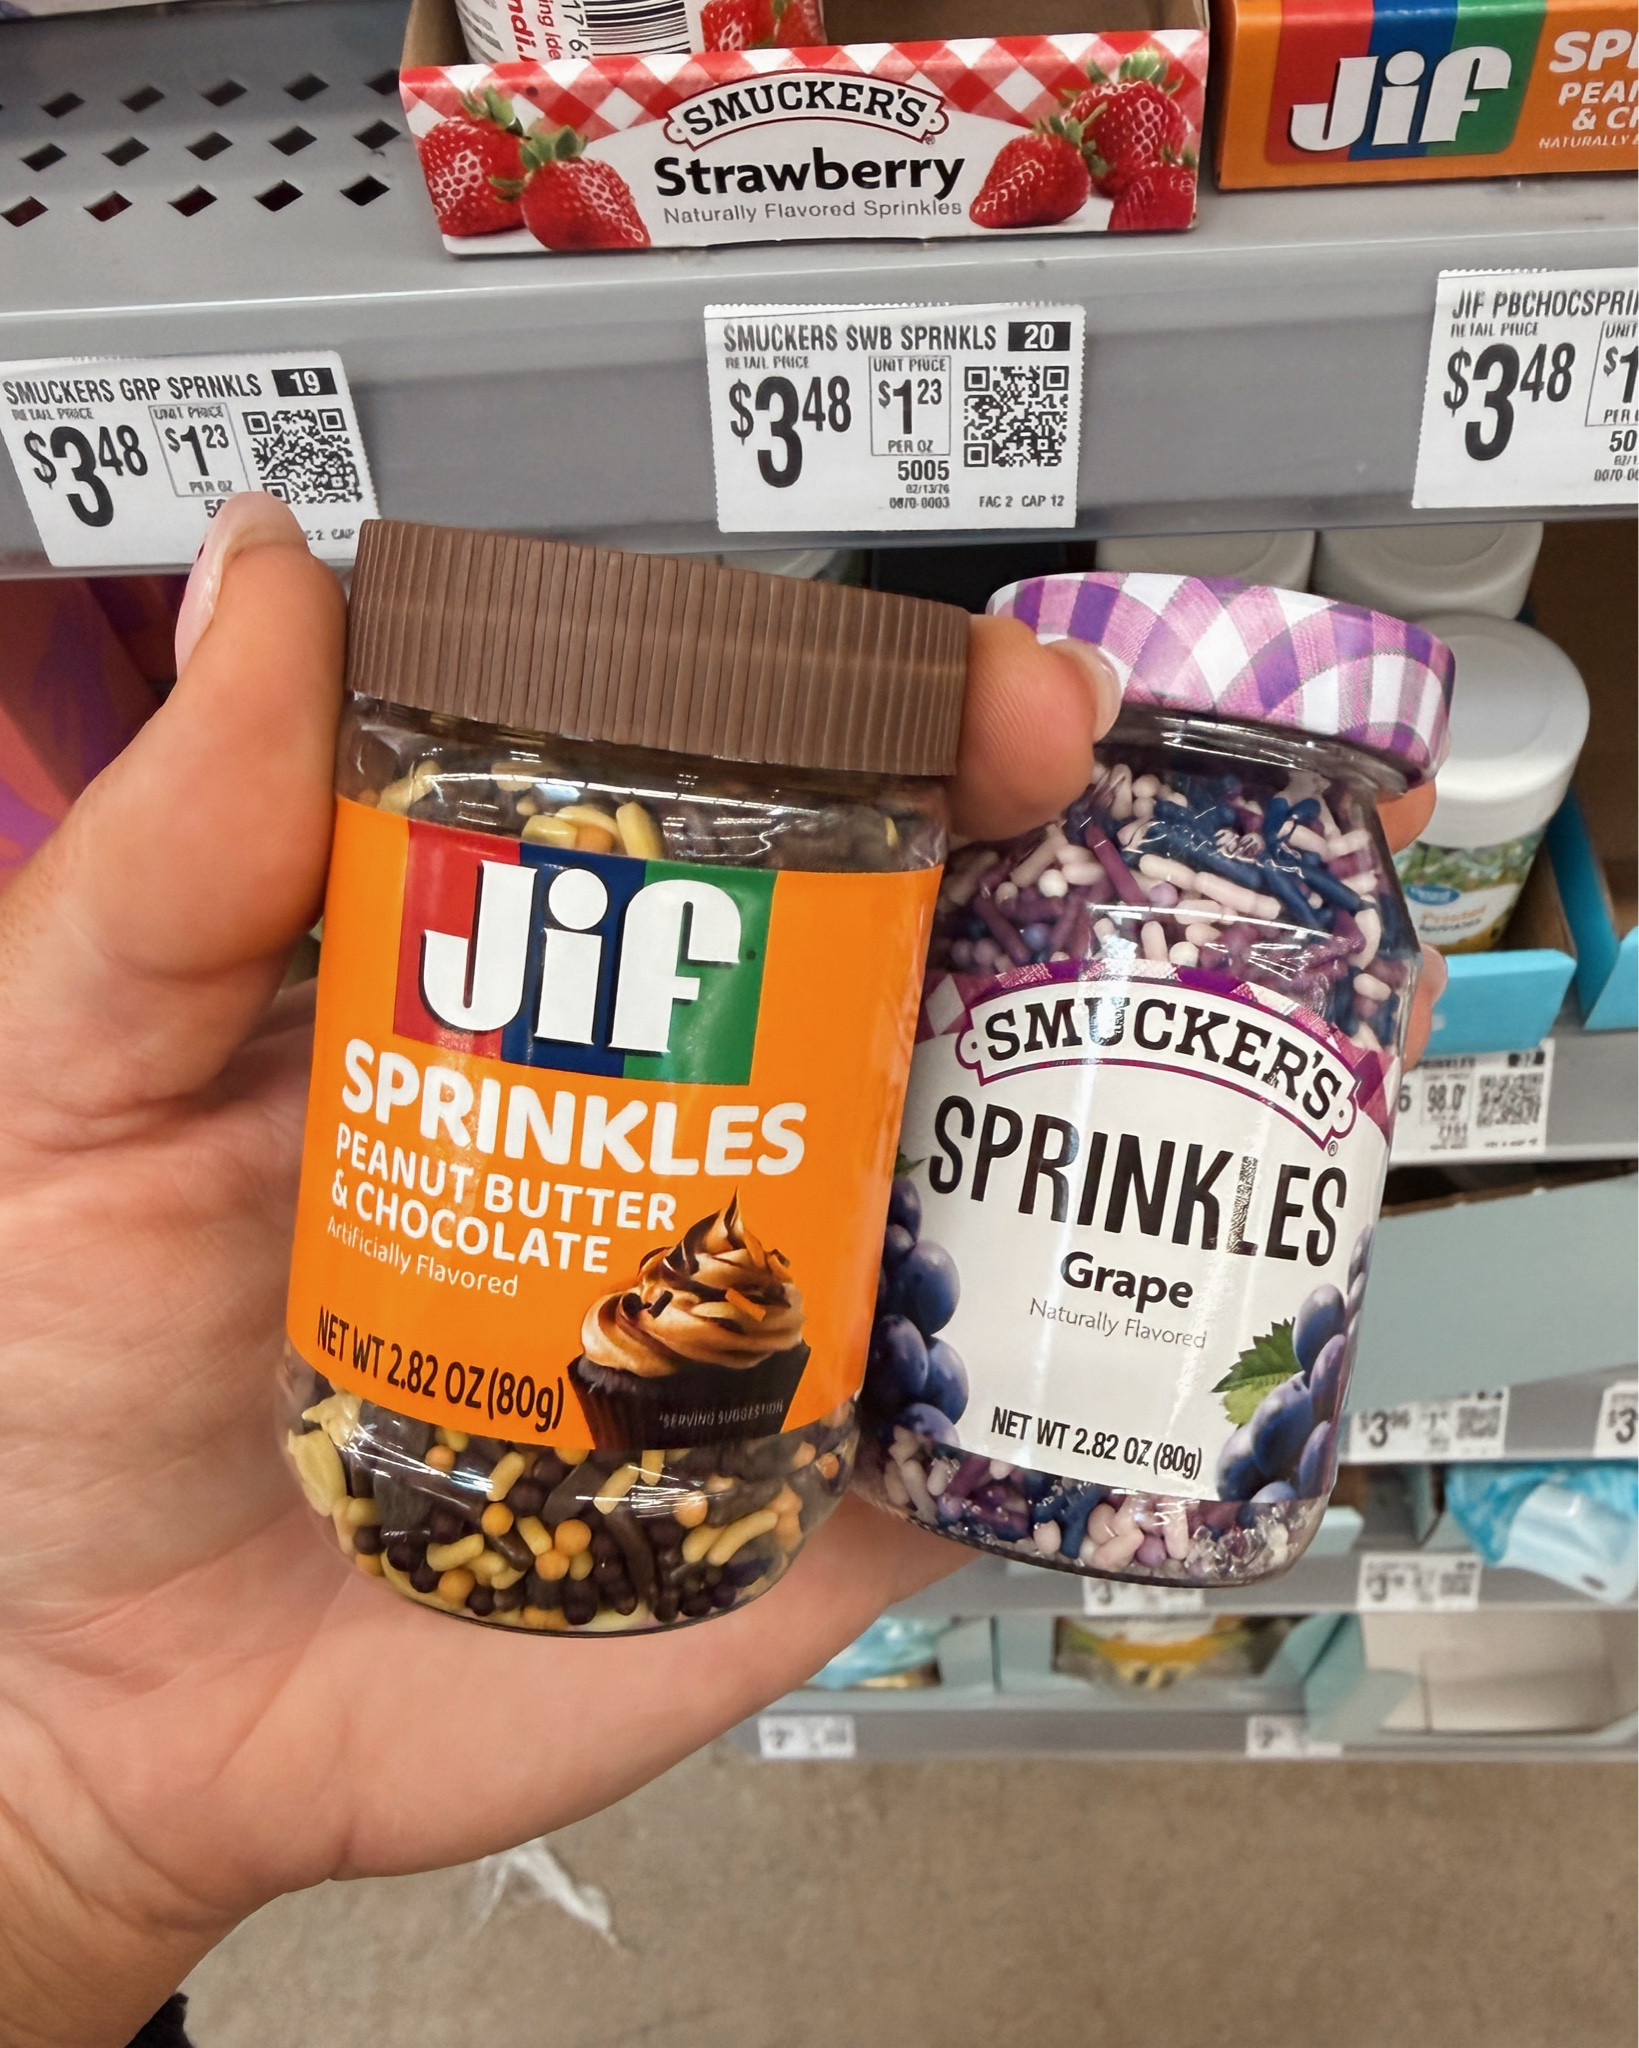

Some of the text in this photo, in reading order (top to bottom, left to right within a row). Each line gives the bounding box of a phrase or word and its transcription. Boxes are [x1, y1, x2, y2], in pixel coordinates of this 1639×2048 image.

[682, 80, 928, 136] SMUCKER'S
[1290, 45, 1512, 151] Jif
[1572, 107, 1597, 131] &
[1538, 134, 1630, 149] NATURALLY
[654, 146, 965, 201] Strawberry
[664, 199, 963, 225] Naturally Flavored Sprinkles
[1452, 289, 1486, 319] JIF
[723, 323, 1056, 352] SMUCKERS SWB SPRNKLS 20
[2, 369, 323, 406] SMUCKERS GRP SPRNKLS 19
[888, 440, 934, 453] PER OZ
[898, 460, 950, 481] 5005
[979, 494, 1065, 508] FAC 2 CAP 12
[419, 859, 743, 1053] Jif
[983, 996, 1343, 1121] SMUCKER'S
[342, 1037, 808, 1178] SPRINKLES
[335, 1122, 677, 1232] PEANUT BUTTER
[928, 1094, 1348, 1267] SPRINKLES
[331, 1169, 611, 1275] & CHOCOLATE
[327, 1215, 519, 1298] Artificially Flavored
[1060, 1250, 1194, 1313] Grape
[1030, 1298, 1208, 1350] Naturally Flavored
[317, 1305, 564, 1433] NET WT 2.82 OZ (80g)
[990, 1406, 1203, 1481] NET WT 2.82 OZ (80g)
